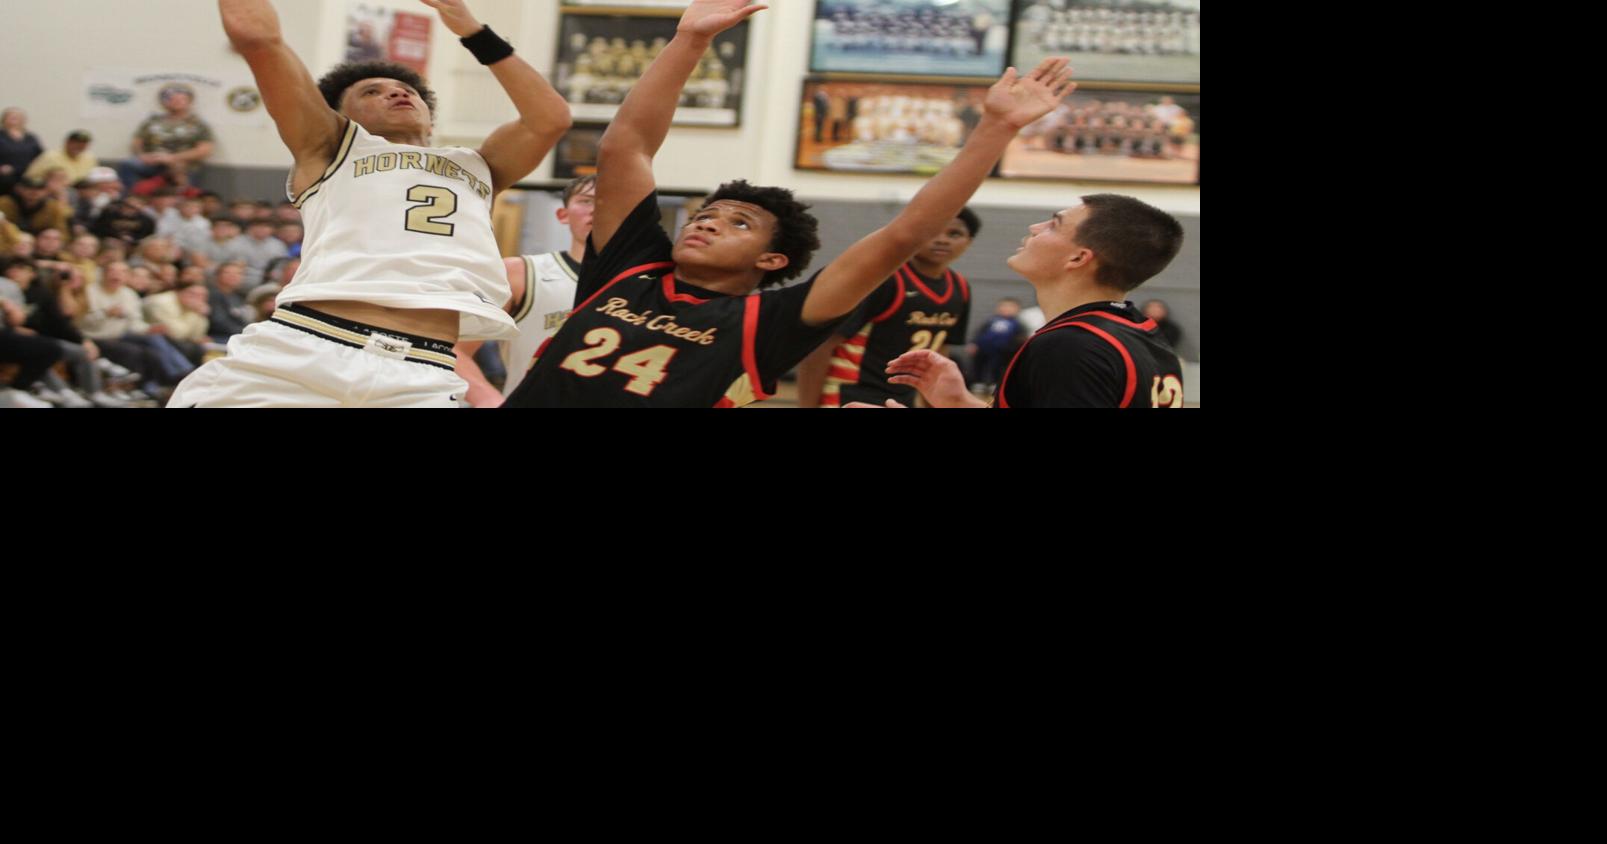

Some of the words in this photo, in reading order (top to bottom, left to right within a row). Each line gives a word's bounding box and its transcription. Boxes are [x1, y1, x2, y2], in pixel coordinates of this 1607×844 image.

[353, 151, 491, 200] HORNETS
[404, 184, 458, 237] 2
[595, 296, 653, 326] Rock
[646, 314, 718, 345] Creek
[559, 326, 679, 397] 24
